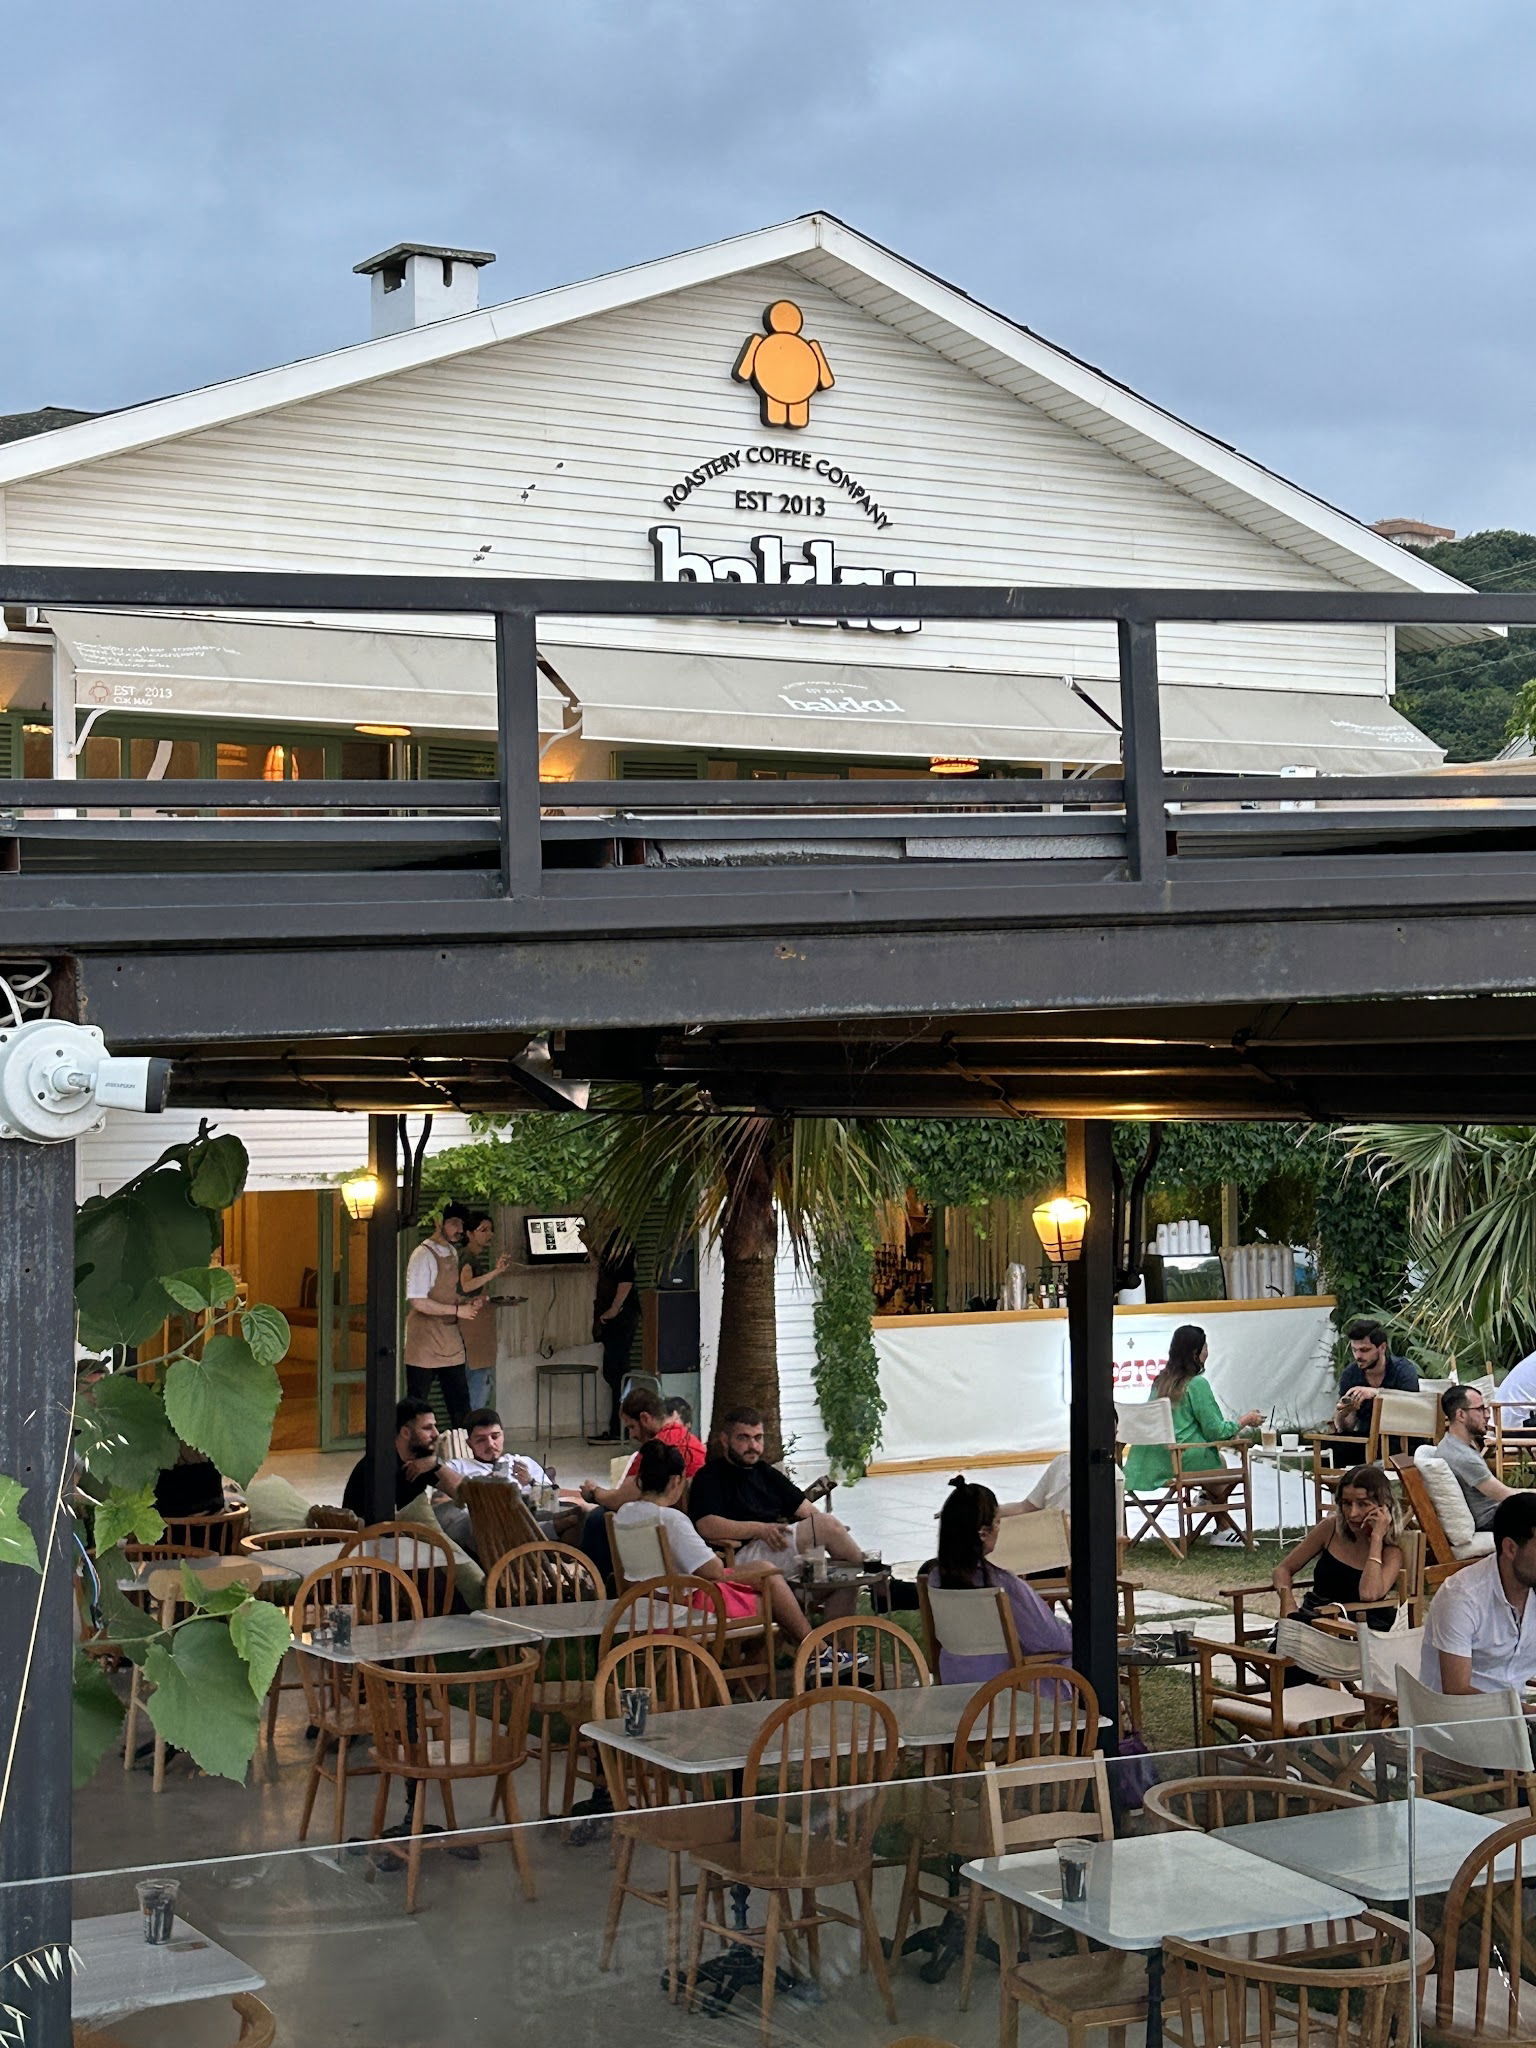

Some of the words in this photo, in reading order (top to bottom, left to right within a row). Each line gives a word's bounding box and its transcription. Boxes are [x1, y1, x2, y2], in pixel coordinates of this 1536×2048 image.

[663, 449, 741, 512] ROASTERY
[746, 445, 812, 470] COFFEE
[815, 458, 893, 530] COMPANY
[735, 489, 773, 512] EST
[779, 494, 827, 517] 2013
[113, 685, 137, 696] EST
[144, 686, 173, 699] 2013
